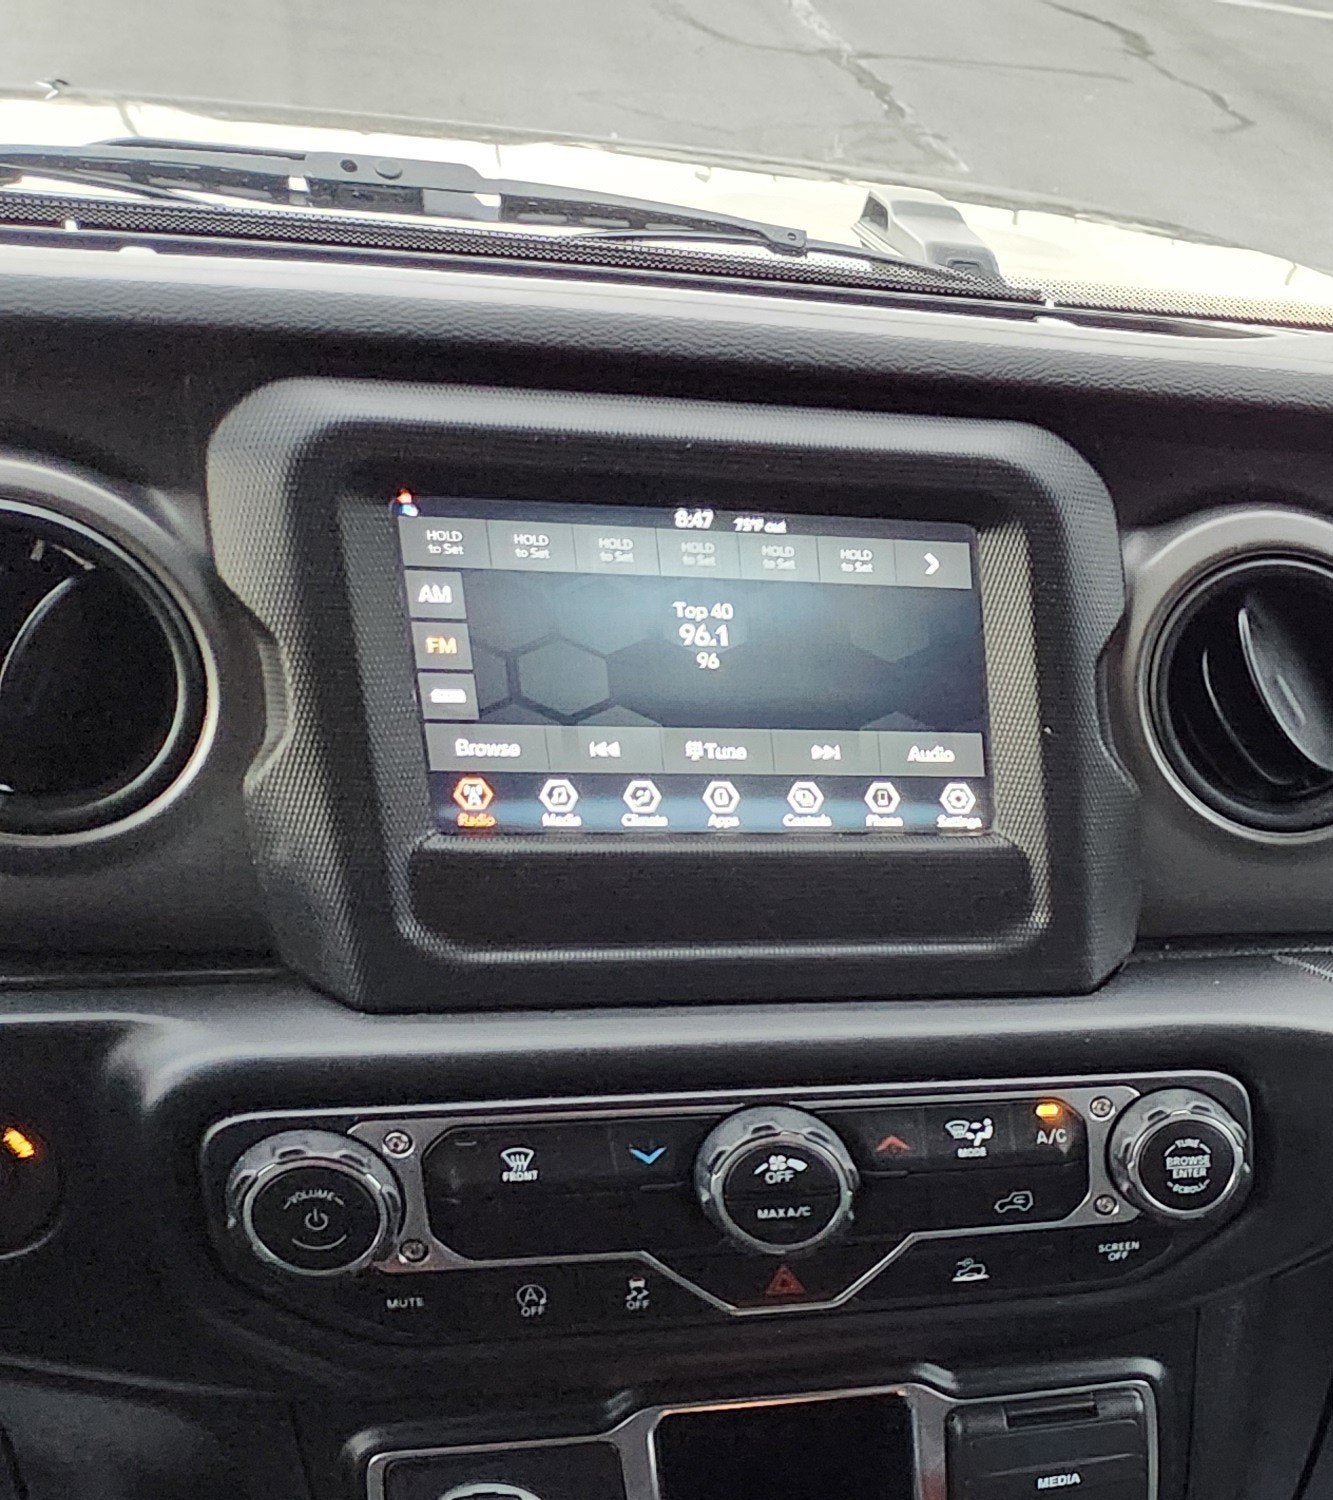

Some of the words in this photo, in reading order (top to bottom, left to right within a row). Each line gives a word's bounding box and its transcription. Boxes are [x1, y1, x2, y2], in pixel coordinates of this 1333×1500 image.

[674, 507, 714, 528] 8:47
[426, 529, 463, 542] HOLD
[513, 533, 549, 547] HOLD
[428, 543, 441, 554] to
[444, 544, 464, 556] Set
[598, 537, 634, 551] HOLD
[681, 542, 716, 554] HOLD
[515, 548, 528, 559] to
[531, 548, 550, 560] Set
[600, 551, 613, 562] to
[615, 552, 634, 563] Set
[762, 545, 795, 558] HOLD
[840, 549, 873, 561] HOLD
[682, 555, 695, 566] to
[696, 554, 716, 567] Set
[762, 558, 775, 570] to
[777, 558, 796, 571] Set
[841, 562, 854, 573] to
[855, 562, 874, 574] Set
[418, 584, 453, 604] AM
[672, 601, 709, 622] Top
[710, 603, 734, 620] 40
[678, 623, 729, 647] 96.1
[426, 636, 458, 655] FM
[696, 652, 721, 670] 96
[455, 738, 521, 758] Browse
[704, 742, 747, 760] Tune
[907, 745, 956, 763] Audio
[1036, 1128, 1069, 1145] A/C
[957, 1147, 988, 1159] MODE
[1166, 1154, 1211, 1168] BROWSE
[502, 1169, 539, 1182] FRONT
[764, 1169, 796, 1185] OFF
[1172, 1168, 1208, 1179] ENTER
[757, 1208, 786, 1220] MAX
[786, 1206, 812, 1218] A/C
[1099, 1241, 1141, 1253] SCREEN
[1108, 1251, 1129, 1262] OFF
[386, 1297, 425, 1309] MUTE
[626, 1299, 651, 1310] OFF
[520, 1305, 546, 1317] OFF
[1037, 1472, 1081, 1490] MEDIA
